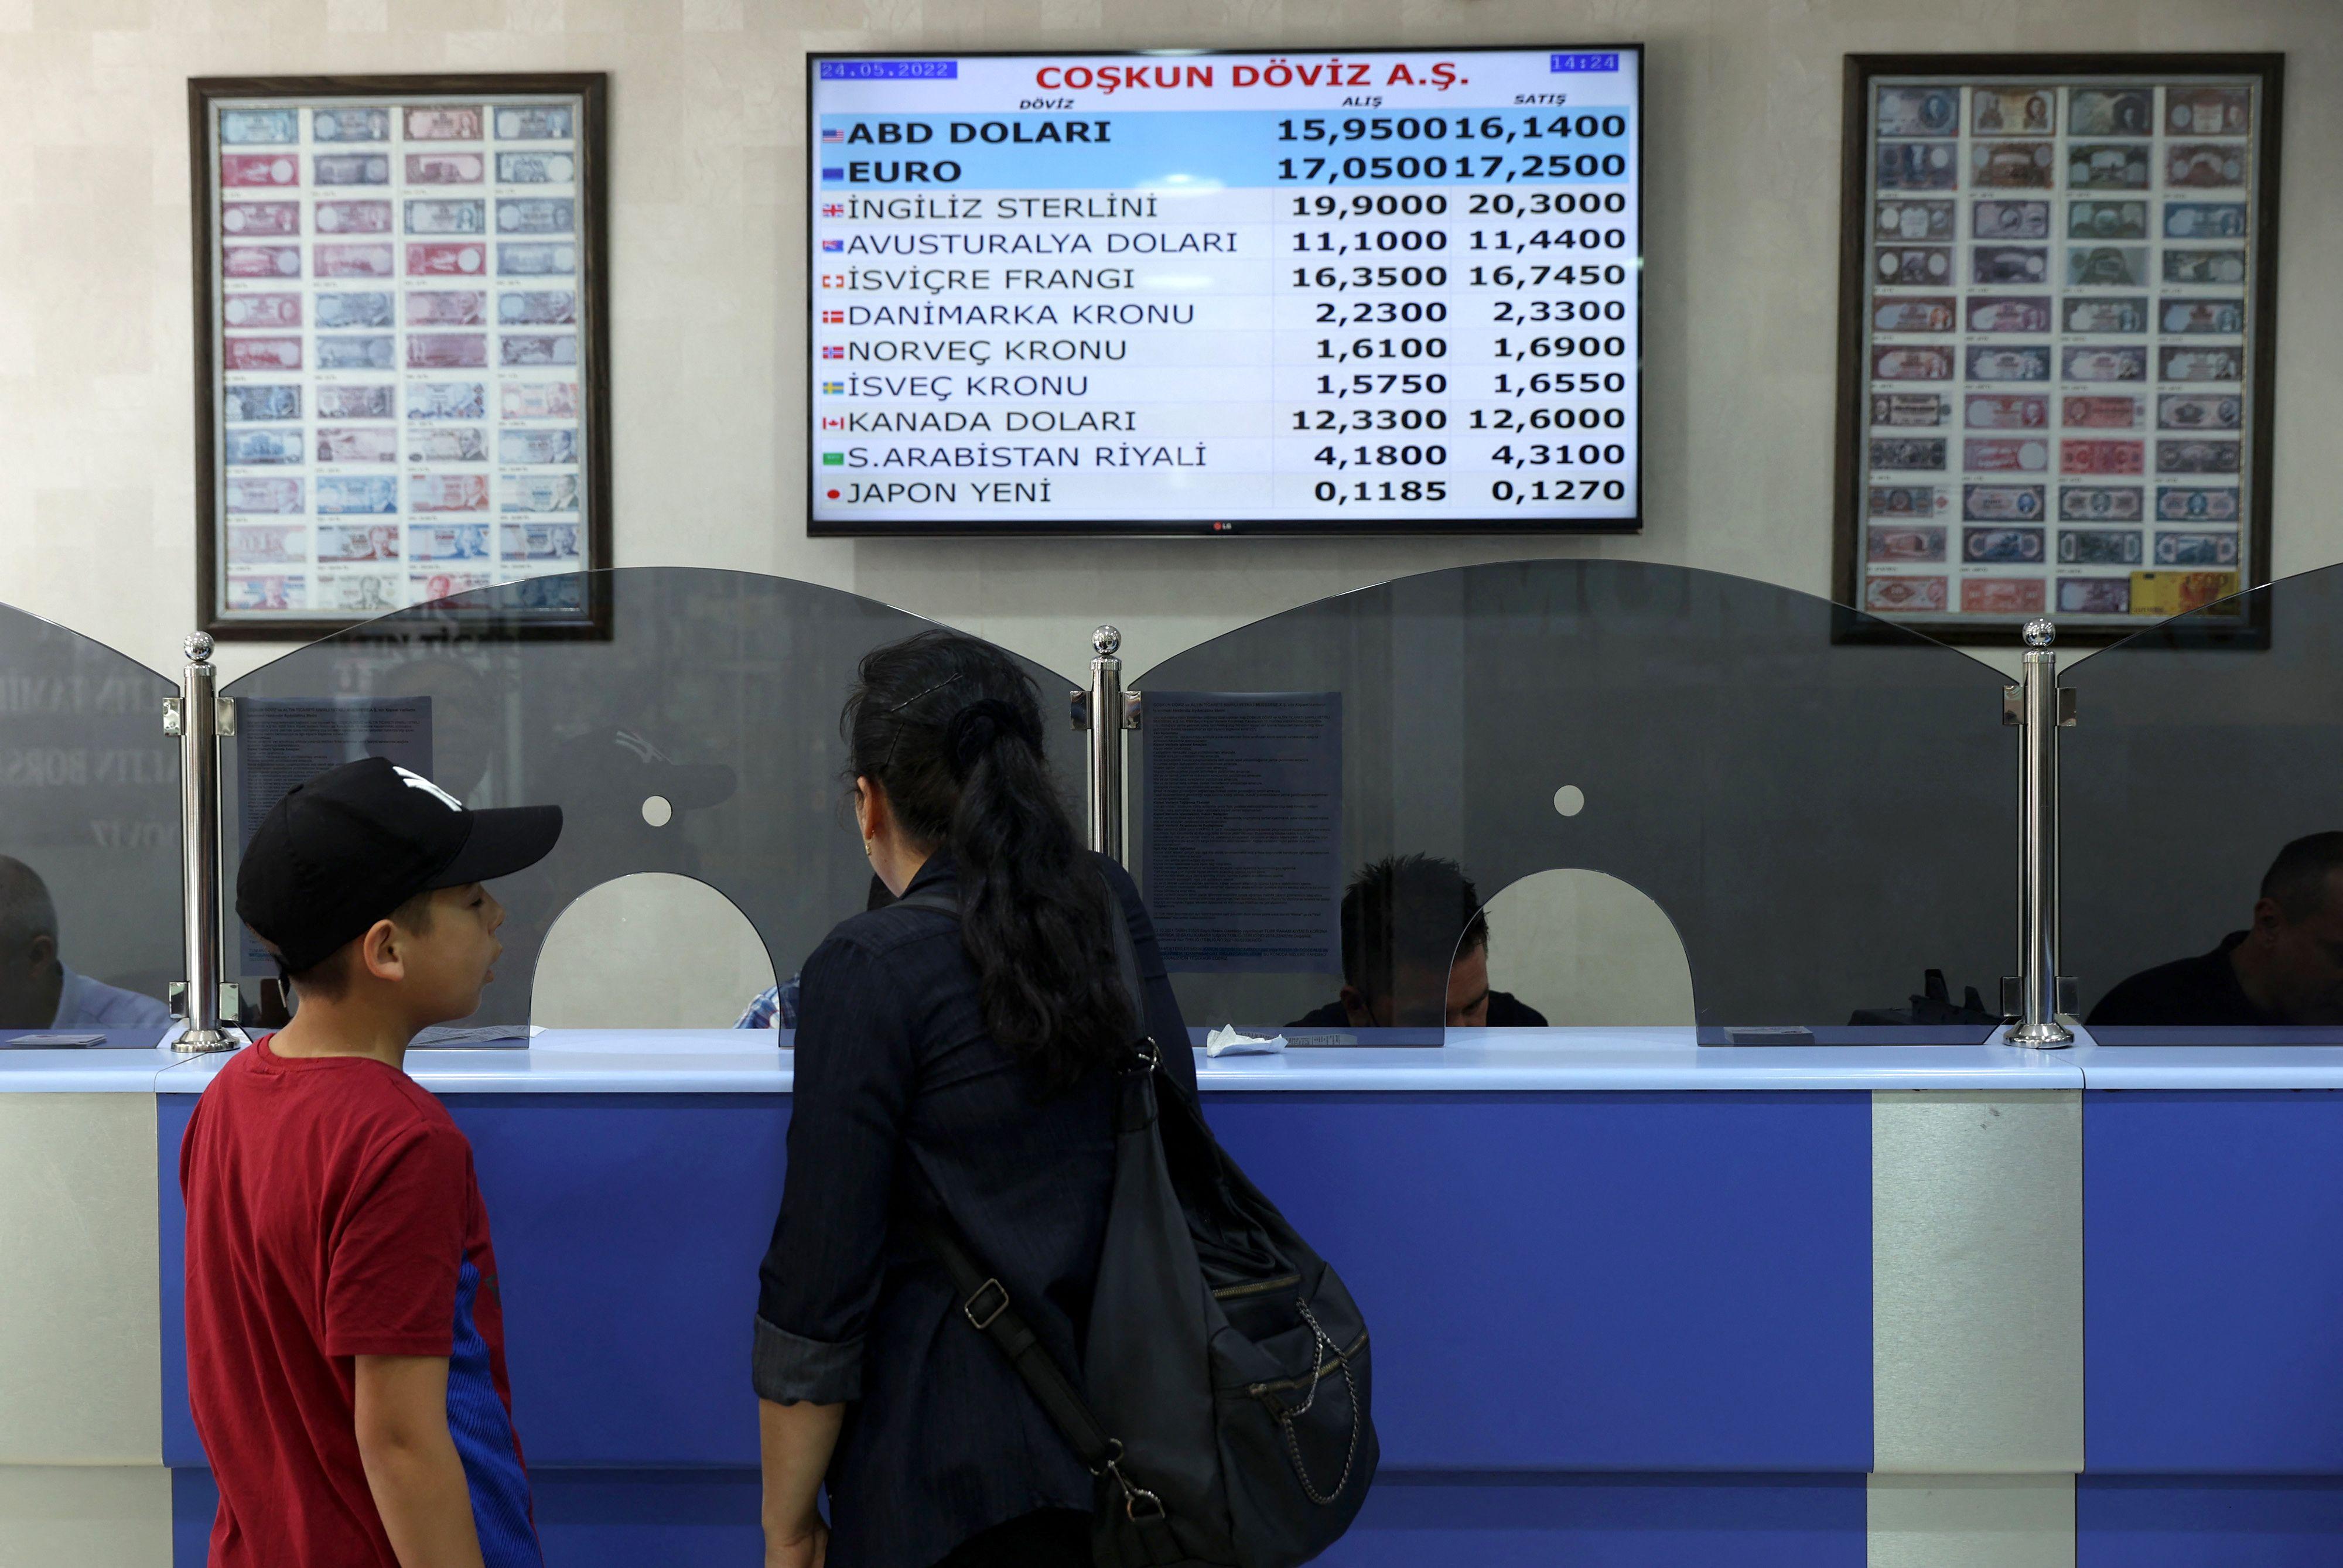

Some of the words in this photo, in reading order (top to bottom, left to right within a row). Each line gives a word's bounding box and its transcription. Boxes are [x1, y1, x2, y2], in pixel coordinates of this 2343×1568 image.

[821, 63, 948, 77] 24.05.2022
[1037, 66, 1213, 94] COŞKUN
[1233, 59, 1370, 87] DÖVİZ
[1388, 63, 1468, 90] A.Ş.
[1552, 56, 1615, 70] 14:24
[1020, 98, 1074, 109] DÖVİZ
[1343, 97, 1382, 107] ALIŞ
[1515, 94, 1566, 105] SATIŞ
[847, 122, 933, 145] ABD
[950, 121, 1111, 144] DOLARI
[1278, 117, 1447, 146] 15,9500
[1456, 114, 1626, 144] 16,1400
[849, 160, 961, 183] EURO
[1279, 156, 1447, 185] 17,0500
[1456, 153, 1625, 183] 17,2500
[849, 194, 981, 219] İNGİLİZ
[998, 193, 1156, 218] STERLİNİ
[1293, 194, 1447, 220] 19,9000
[1469, 193, 1625, 218] 20,3000
[848, 234, 1091, 254] AVUSTURALYA
[1108, 233, 1236, 253] DOLARI
[1293, 231, 1447, 255] 11,1000
[1470, 228, 1625, 254] 11,4400
[849, 266, 988, 295] İSVİÇRE
[1006, 269, 1133, 289] FRANGI
[1293, 267, 1447, 292] 16,3500
[1470, 265, 1625, 290] 16,7450
[849, 302, 1057, 325] DANİMARKA
[1074, 305, 1193, 324] KRONU
[1316, 302, 1447, 327] 2,2300
[1494, 300, 1625, 326] 2,3300
[849, 340, 990, 365] NORVEÇ
[1006, 340, 1125, 360] KRONU
[1317, 338, 1447, 363] 1,6100
[1495, 336, 1625, 361] 1,6900
[849, 373, 951, 401] İSVEÇ
[968, 376, 1087, 396] KRONU
[1317, 374, 1447, 398] 1,5750
[1495, 373, 1625, 397] 1,6550
[849, 412, 991, 432] KANADA
[1007, 411, 1135, 432] DOLARI
[1293, 409, 1447, 434] 12,3300
[1470, 408, 1625, 433] 12,6000
[849, 443, 1078, 468] S.ARABİSTAN
[1097, 442, 1205, 466] RİYALİ
[1314, 445, 1447, 470] 4,1800
[1491, 444, 1625, 469] 4,3100
[847, 483, 955, 504] JAPON
[971, 478, 1050, 502] YENİ
[1315, 481, 1446, 505] 0,1185
[1492, 480, 1625, 505] 0,1270
